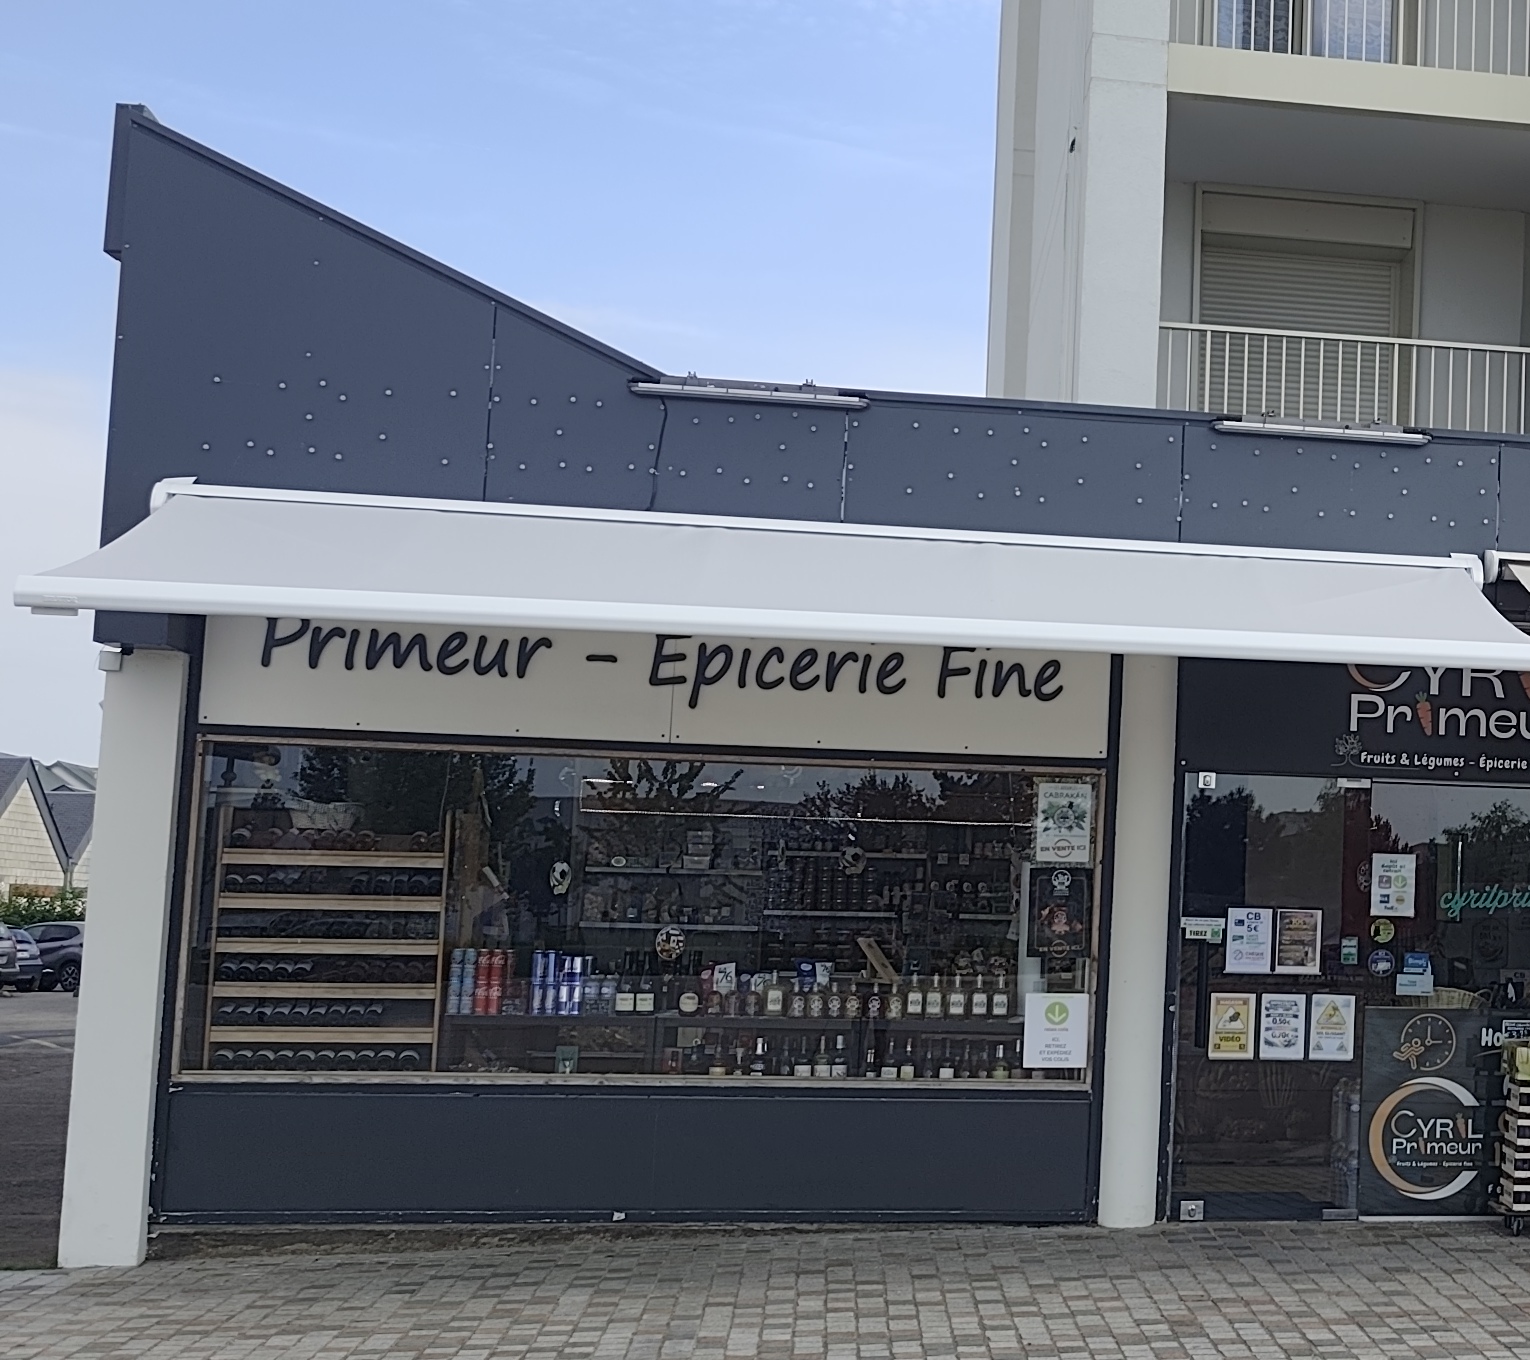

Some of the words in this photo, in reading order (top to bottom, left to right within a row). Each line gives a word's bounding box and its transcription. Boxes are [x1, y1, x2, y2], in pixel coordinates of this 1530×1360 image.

[260, 616, 553, 680] Primeur
[937, 645, 1064, 703] Fine
[1360, 751, 1397, 766] Fruits
[1400, 753, 1410, 766] &
[1414, 753, 1465, 770] Légumes
[1479, 753, 1528, 772] Épicerie
[1246, 912, 1261, 921] CB
